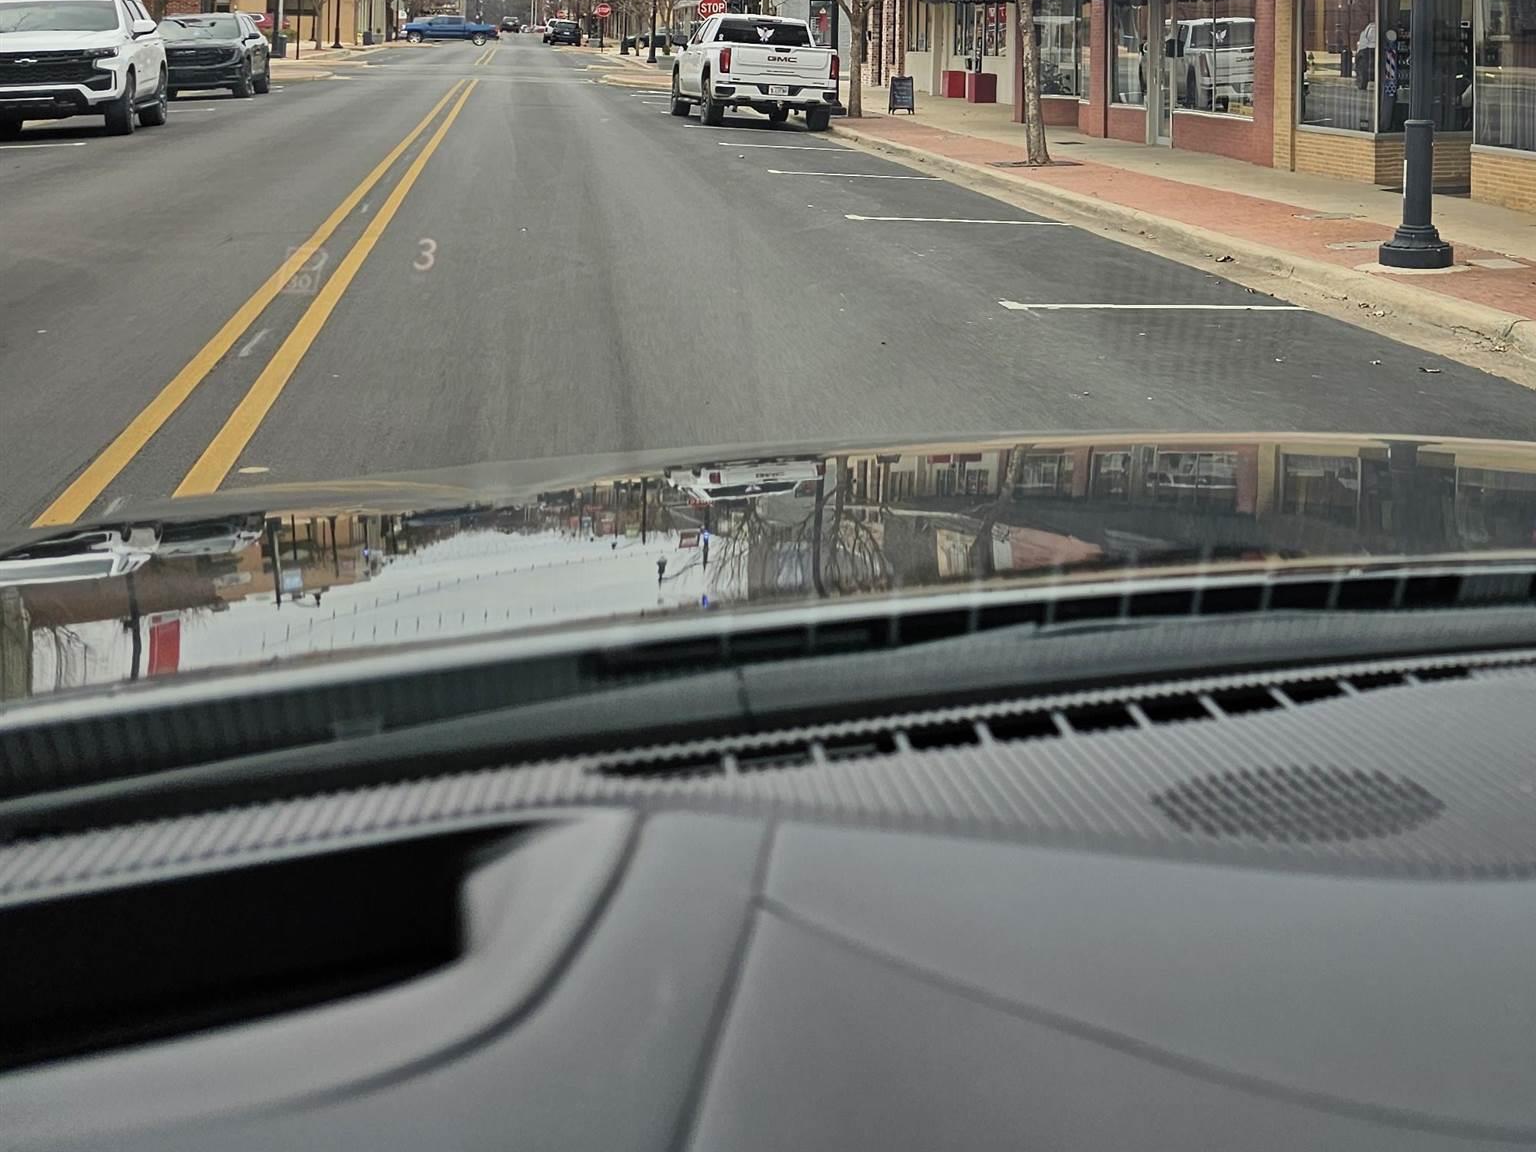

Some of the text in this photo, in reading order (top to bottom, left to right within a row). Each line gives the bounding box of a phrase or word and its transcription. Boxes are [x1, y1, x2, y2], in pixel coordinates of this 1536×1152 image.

[701, 3, 725, 13] STOP
[767, 55, 798, 63] GMC
[412, 238, 437, 271] 3
